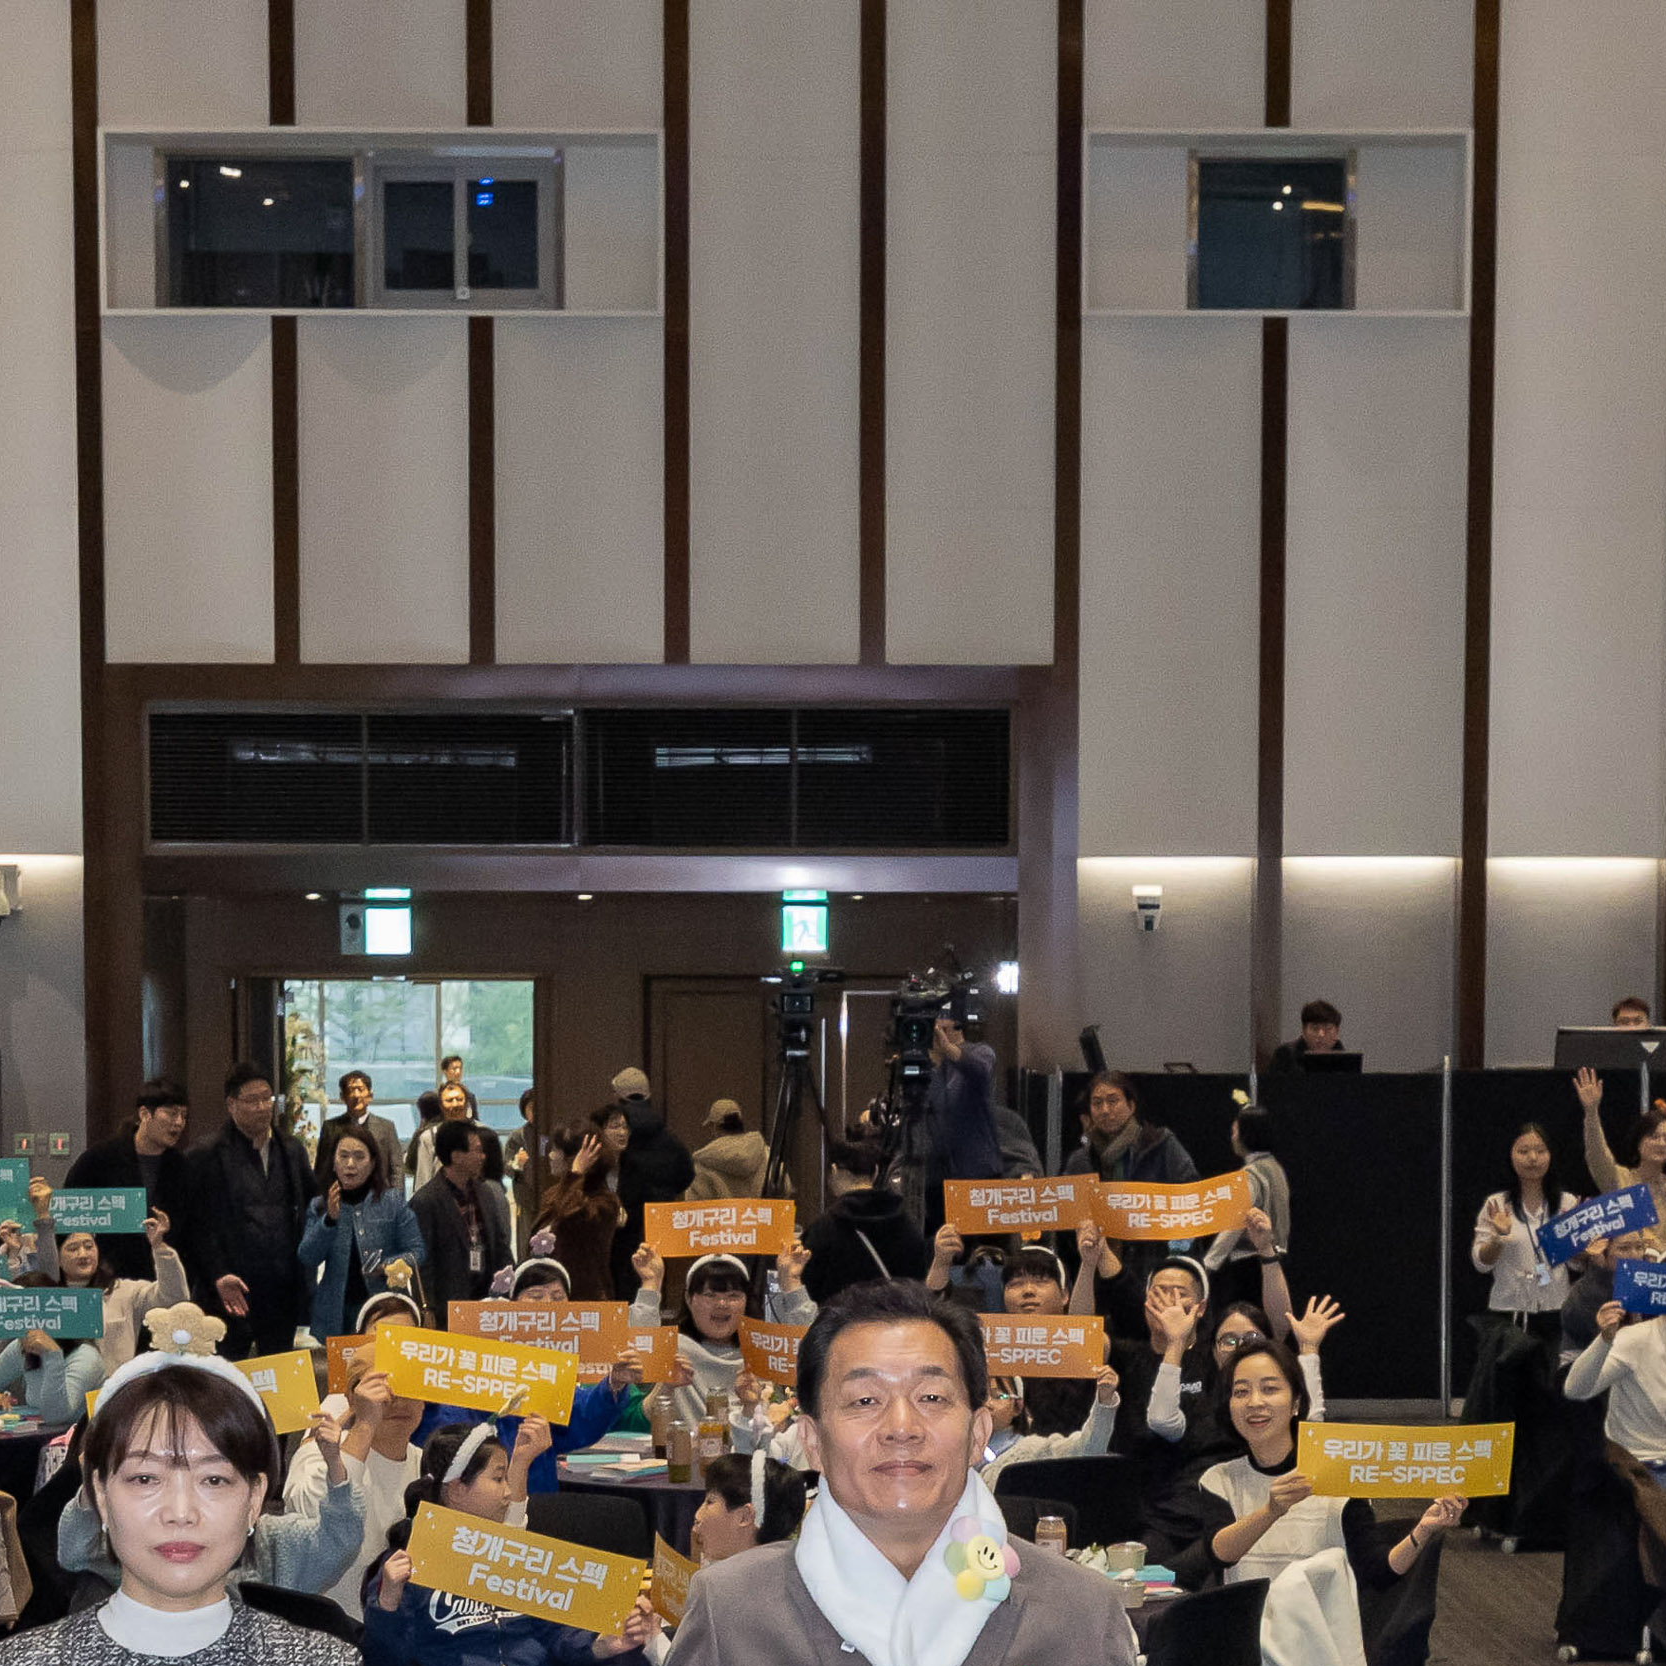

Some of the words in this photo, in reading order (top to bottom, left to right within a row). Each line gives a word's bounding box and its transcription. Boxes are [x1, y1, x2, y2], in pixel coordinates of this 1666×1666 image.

[97, 1195, 126, 1211] 스펙
[969, 1188, 1035, 1207] 청개구리
[1039, 1184, 1075, 1203] 스펙
[1107, 1193, 1150, 1209] 우리가
[1170, 1194, 1199, 1210] 피운
[1203, 1185, 1232, 1207] 스펙
[53, 1213, 111, 1227] Festival
[672, 1208, 736, 1228] 청개구리
[741, 1207, 772, 1226] 스펙
[987, 1207, 1058, 1225] Festival
[1128, 1209, 1214, 1229] RE-SPPEC
[689, 1229, 756, 1247] Festival
[1571, 1215, 1625, 1245] Festival
[45, 1296, 78, 1313] 스펙
[479, 1312, 556, 1333] 청개구리
[560, 1312, 600, 1333] 스펙
[751, 1333, 788, 1352] 우리가
[994, 1327, 1012, 1344] 꽃
[1015, 1327, 1046, 1346] 피운
[1051, 1328, 1085, 1345] 스펙
[400, 1342, 455, 1366] 우리가
[458, 1351, 476, 1370] 꽃
[481, 1354, 517, 1378] 피운
[521, 1361, 557, 1385] 스펙
[423, 1369, 531, 1402] RE-SPPEC
[1324, 1439, 1382, 1460] 우리가
[1388, 1440, 1406, 1461] 꽃
[1412, 1442, 1450, 1462] 피운
[1455, 1439, 1492, 1461] 스펙
[1349, 1465, 1465, 1484] RE-SPPEC
[452, 1526, 553, 1576] 청개구리
[555, 1556, 608, 1589] 스펙
[468, 1563, 574, 1612] Festival
